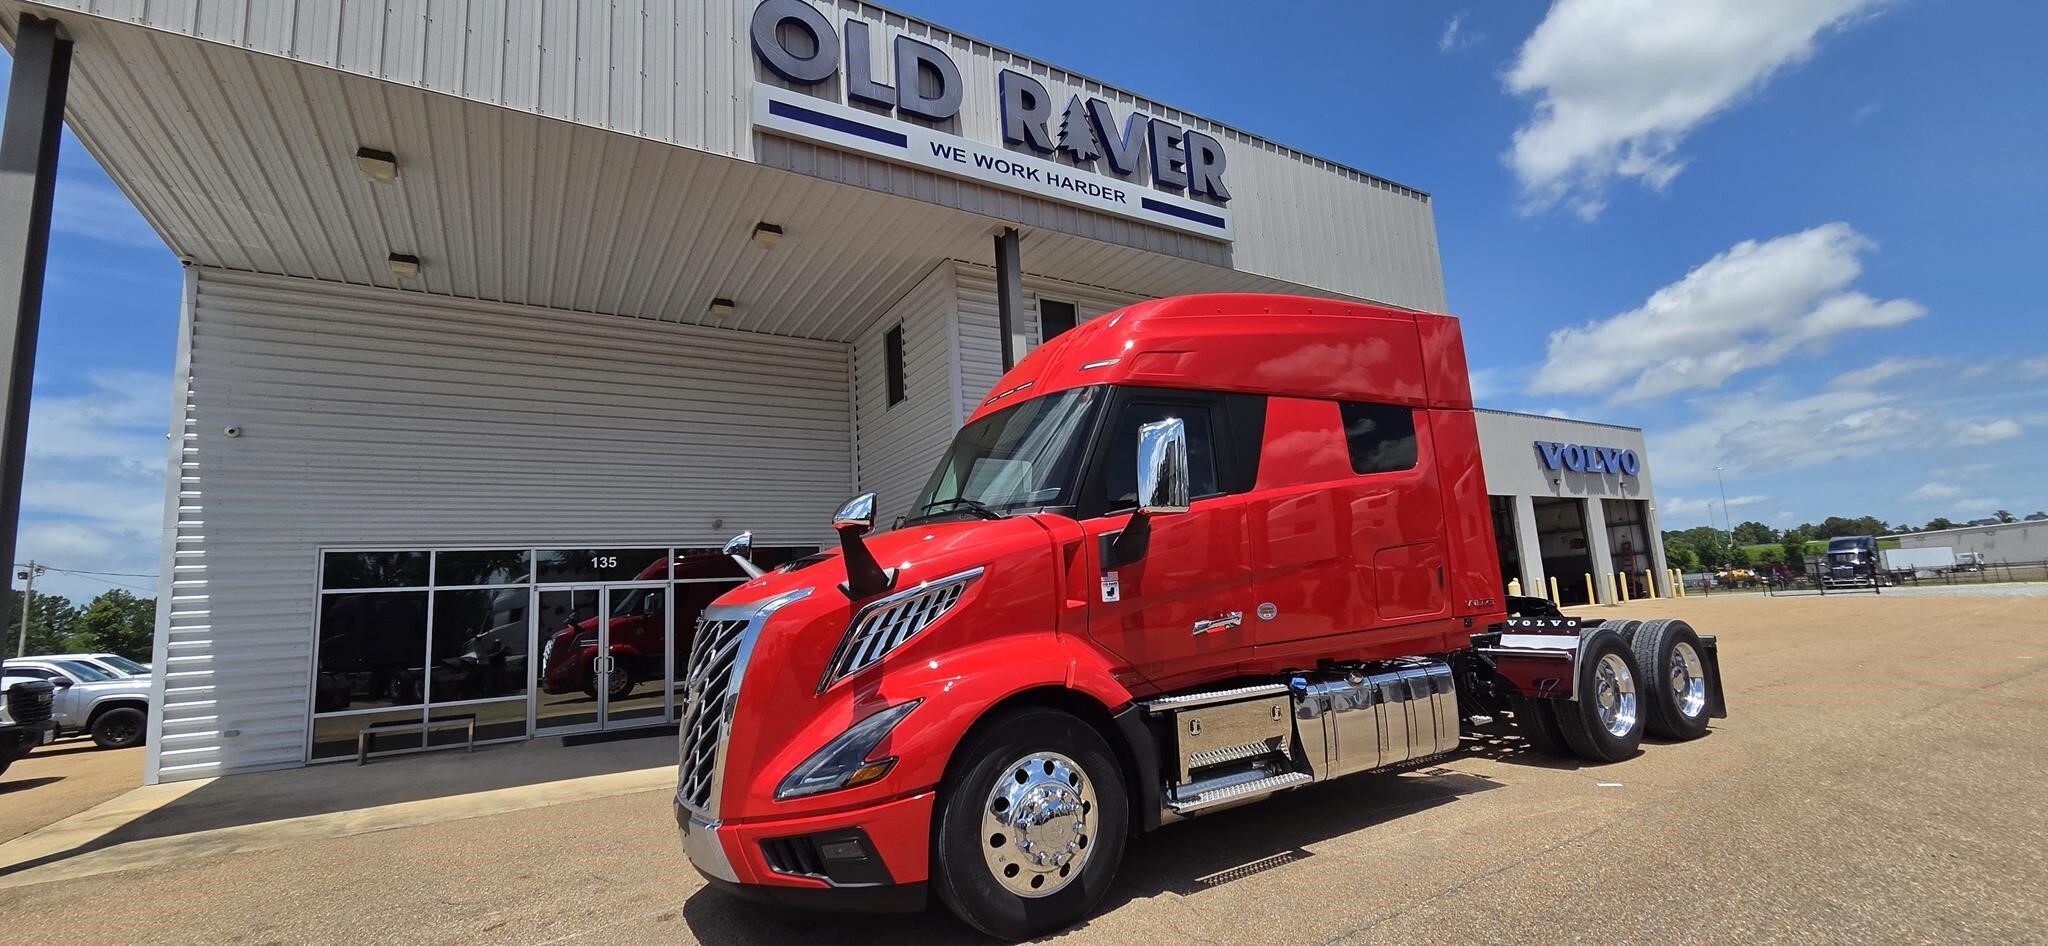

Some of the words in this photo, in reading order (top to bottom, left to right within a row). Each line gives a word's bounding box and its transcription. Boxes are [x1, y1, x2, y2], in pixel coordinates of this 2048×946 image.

[750, 0, 963, 122] OLD
[930, 141, 967, 164] WE
[973, 152, 1041, 183] WORK
[1046, 171, 1127, 205] HARDER
[1533, 440, 1640, 477] VOLVO
[591, 556, 617, 569] 135
[1506, 619, 1577, 628] VOLVO
